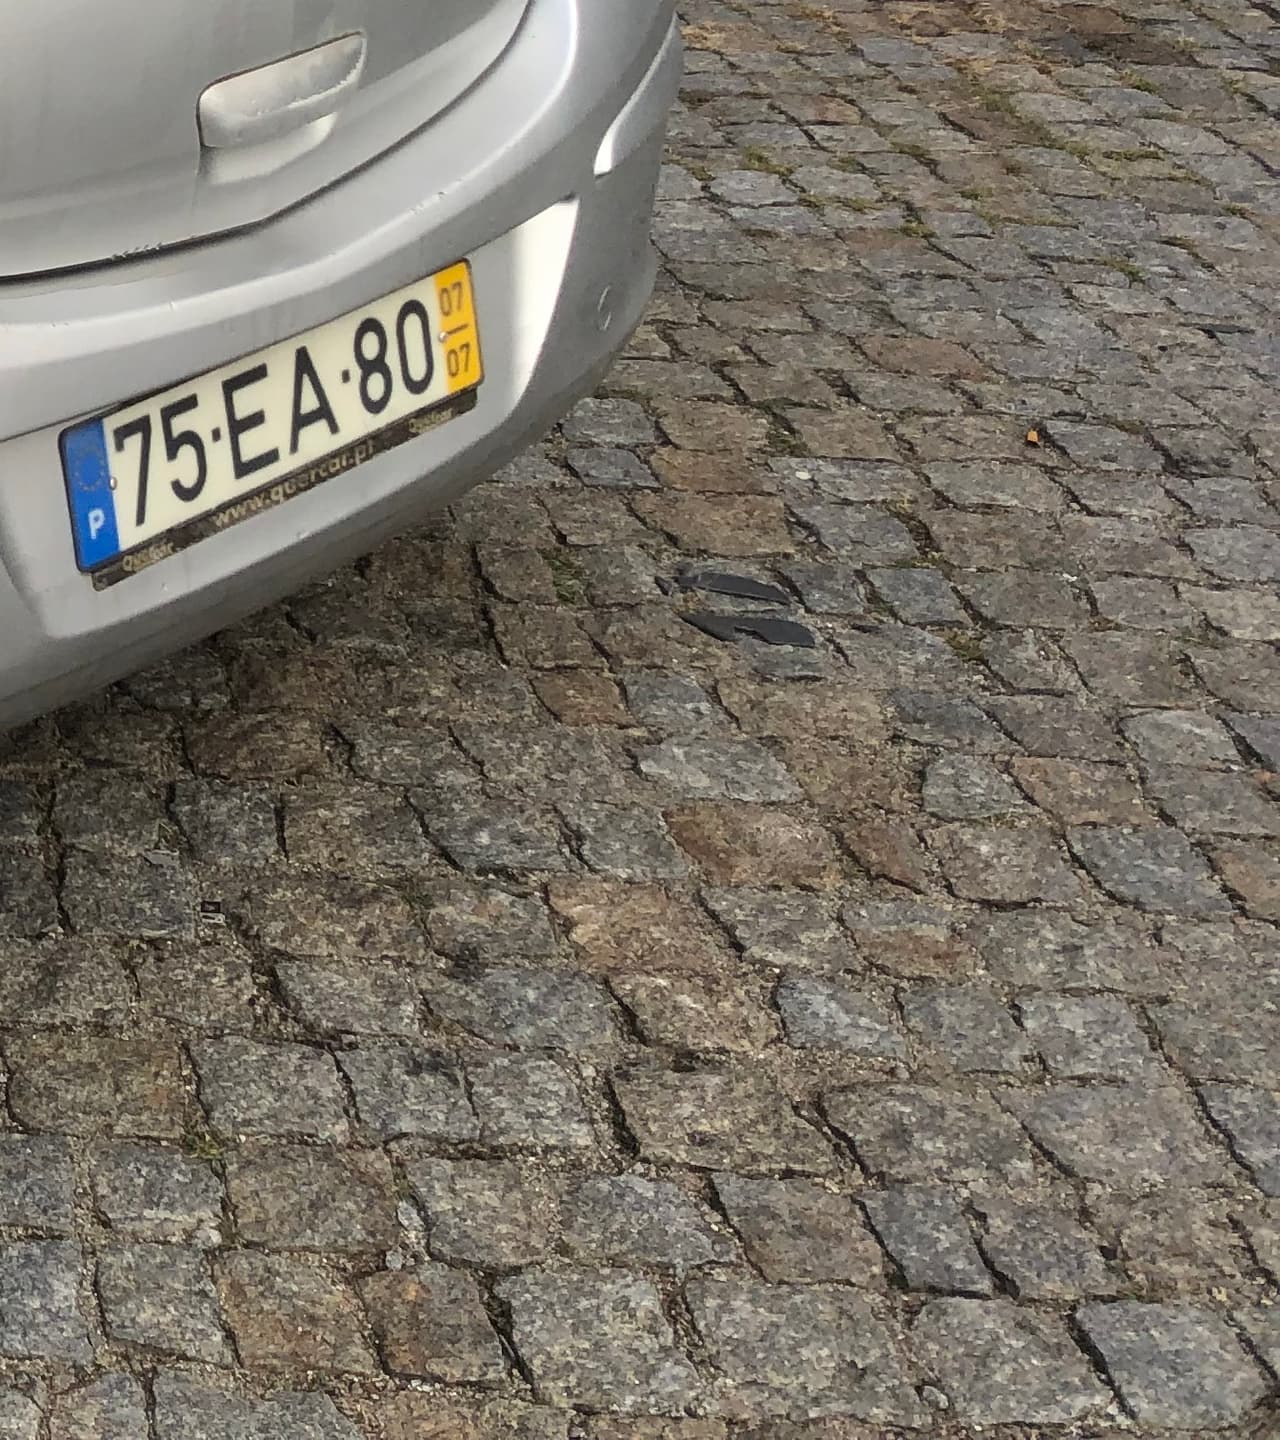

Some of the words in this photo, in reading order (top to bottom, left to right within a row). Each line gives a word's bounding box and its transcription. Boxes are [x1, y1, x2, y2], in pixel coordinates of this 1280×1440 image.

[440, 281, 462, 316] 07
[446, 342, 470, 377] 07
[88, 509, 106, 539] P
